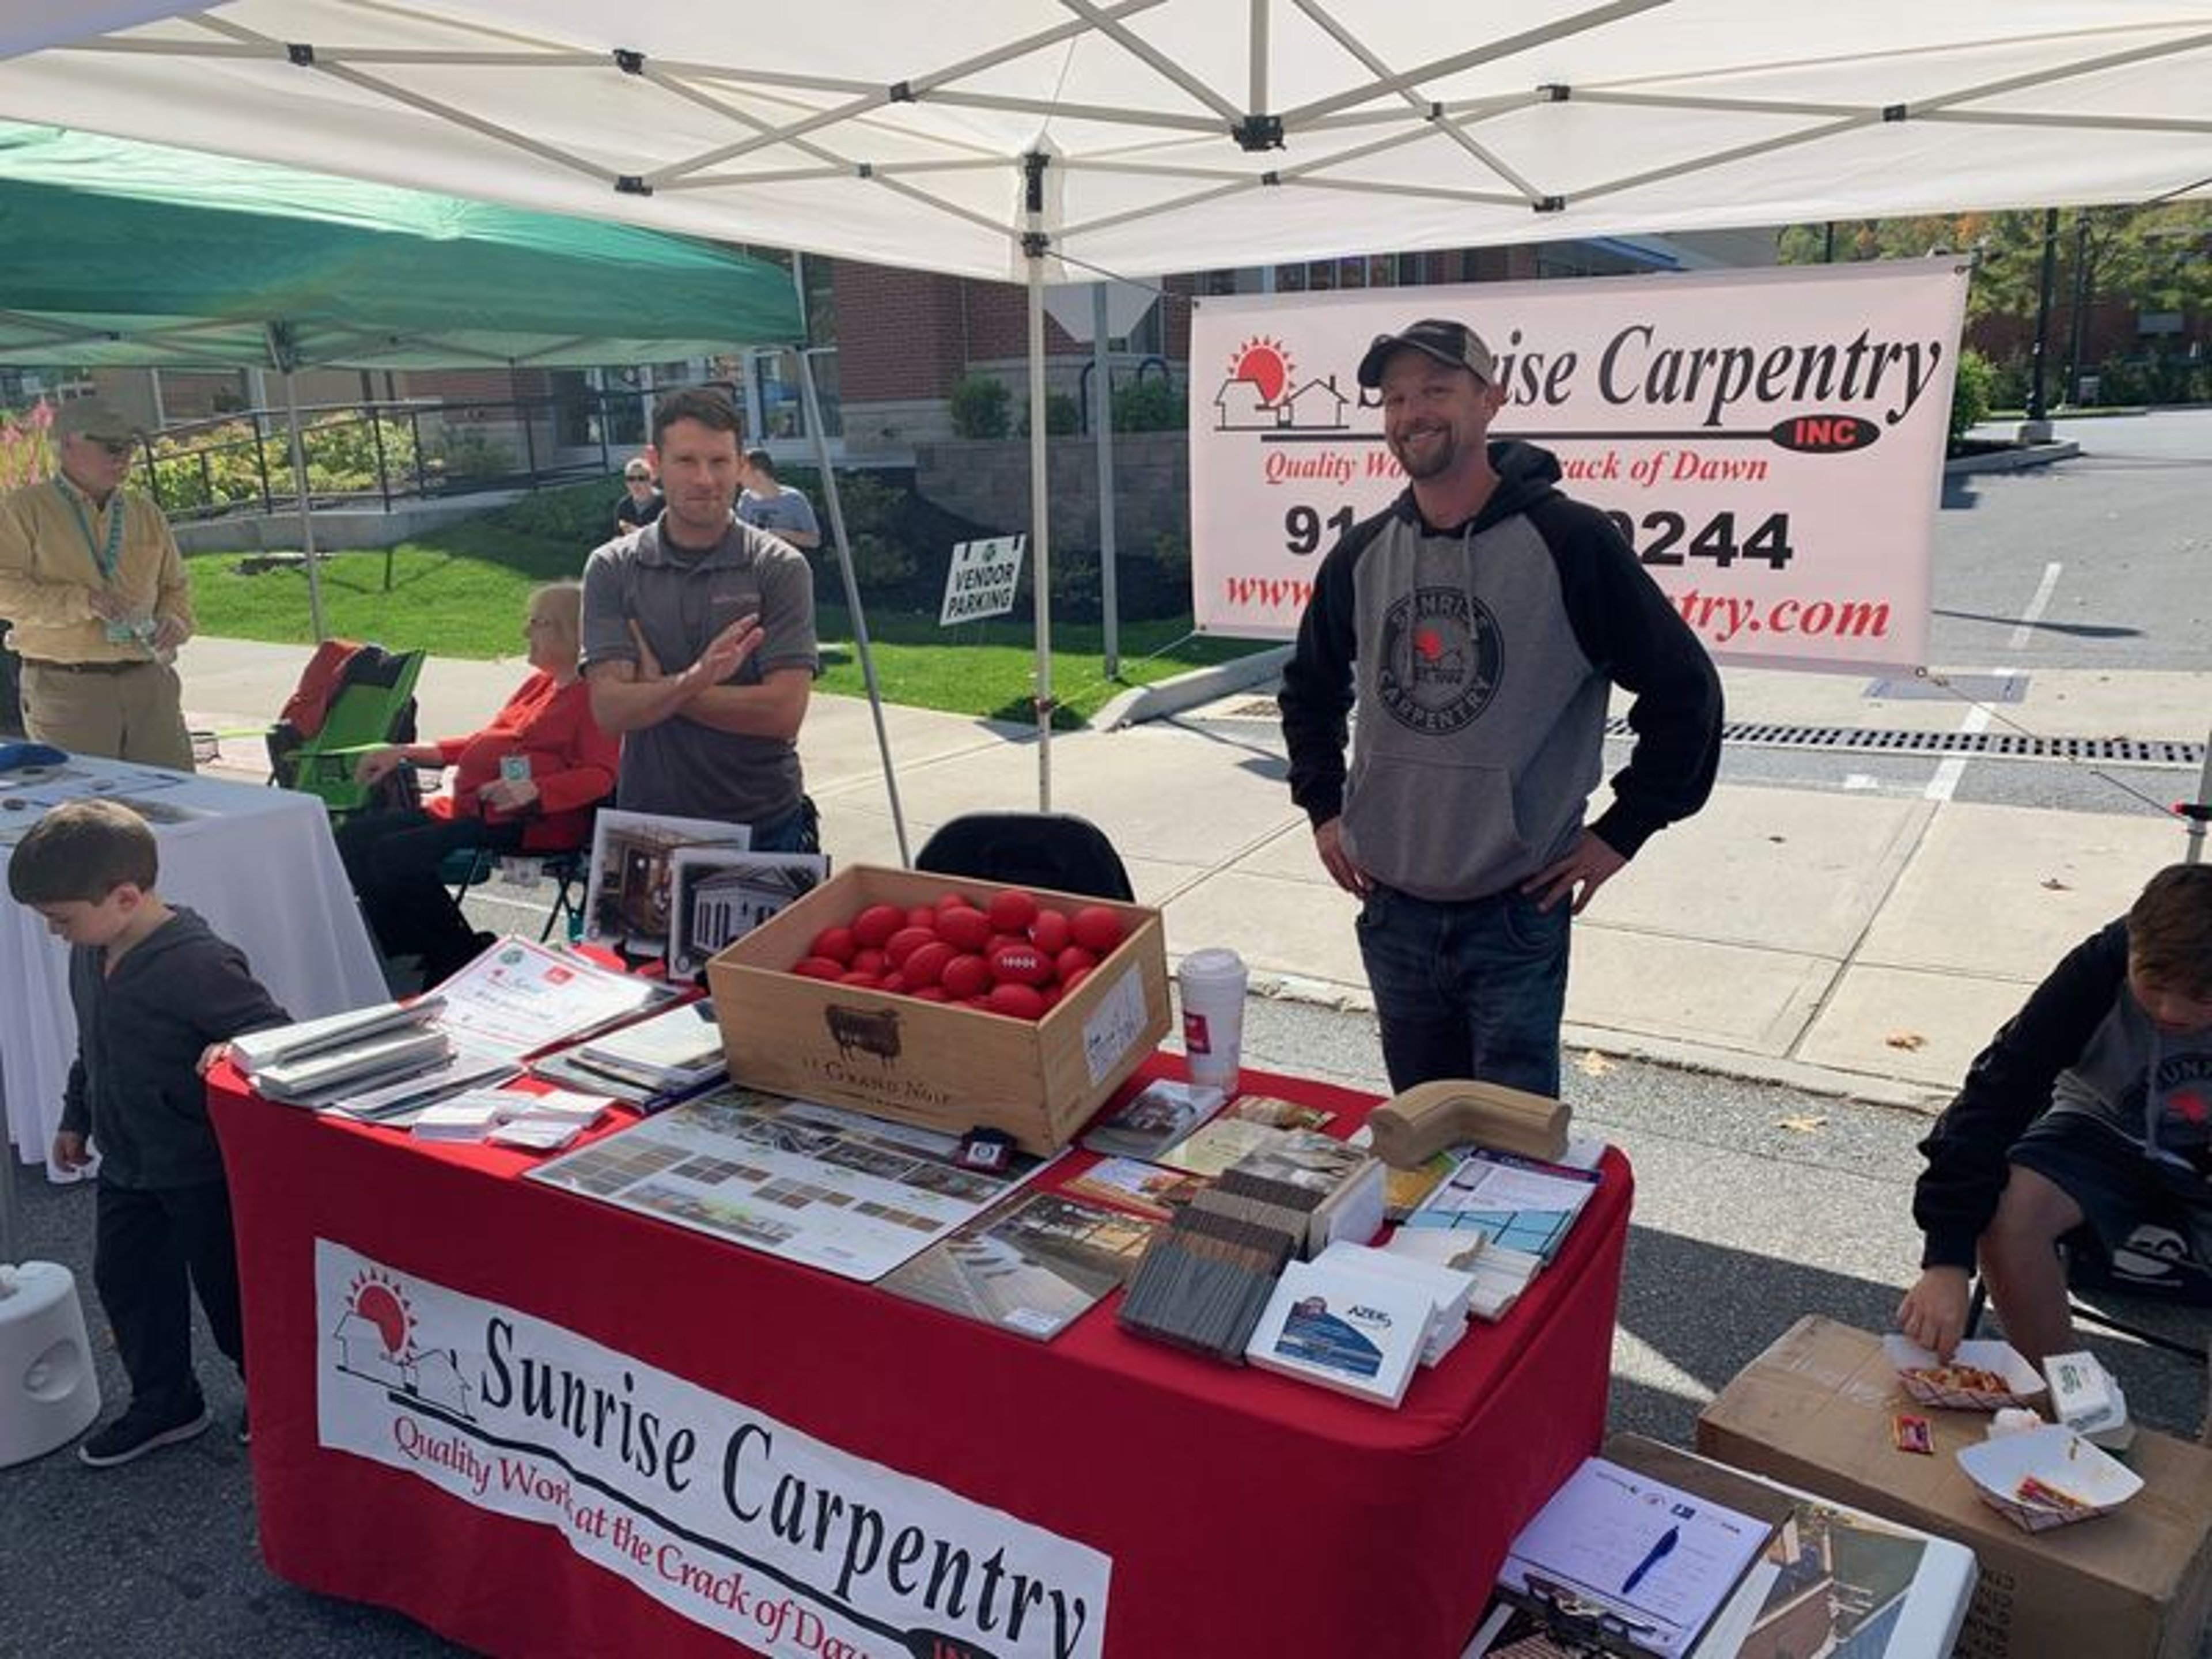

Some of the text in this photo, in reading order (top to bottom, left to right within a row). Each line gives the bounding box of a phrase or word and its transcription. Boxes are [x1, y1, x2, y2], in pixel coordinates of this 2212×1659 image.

[1598, 325, 1942, 426] Carpentry
[1794, 420, 1857, 445] INC
[1266, 450, 1769, 488] Quality Wo ack of Dawn
[956, 562, 1015, 593] VENDOR
[945, 586, 1012, 620] PARKING
[481, 1316, 1086, 1659] Sunrise Carpentry
[393, 1415, 491, 1496] Quality
[575, 1506, 608, 1539] at
[612, 1514, 652, 1566] the
[657, 1543, 751, 1615] Crack
[755, 1599, 794, 1643] of
[792, 1605, 868, 1659] Da
